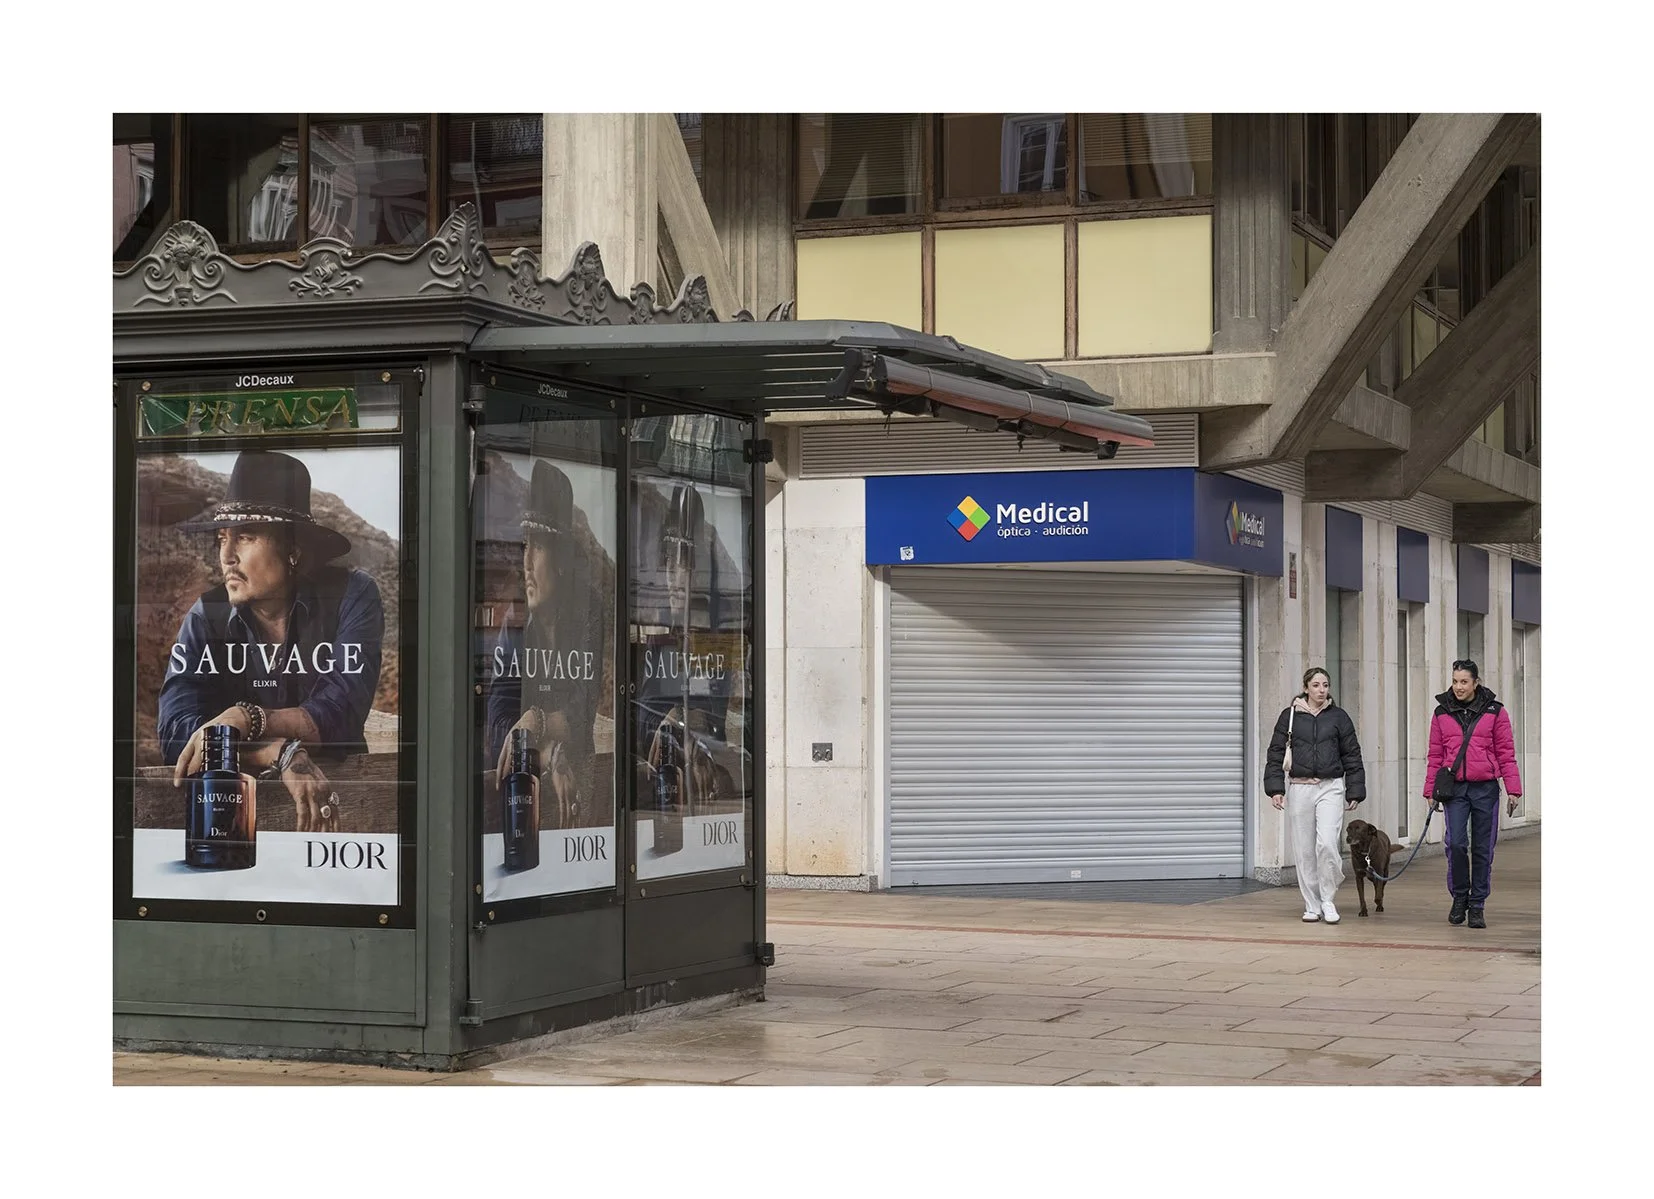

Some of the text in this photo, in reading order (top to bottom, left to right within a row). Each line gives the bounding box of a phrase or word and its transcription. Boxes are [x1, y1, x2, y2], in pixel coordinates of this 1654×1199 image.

[235, 374, 295, 388] JCDecaux
[537, 383, 568, 399] JCDecaux
[185, 394, 353, 432] PRENSA
[996, 501, 1089, 524] Medical
[1241, 511, 1265, 536] Medical
[997, 524, 1089, 539] óptica audición
[170, 642, 365, 675] SAUVAGE
[493, 646, 595, 680] SAUVAGE
[645, 650, 725, 680] SAUVAGE
[253, 680, 277, 688] ELIXIR
[197, 793, 243, 804] SAUVAGE
[703, 820, 738, 847] DIOR
[304, 840, 388, 871] DIOR
[563, 834, 607, 864] DIOR
